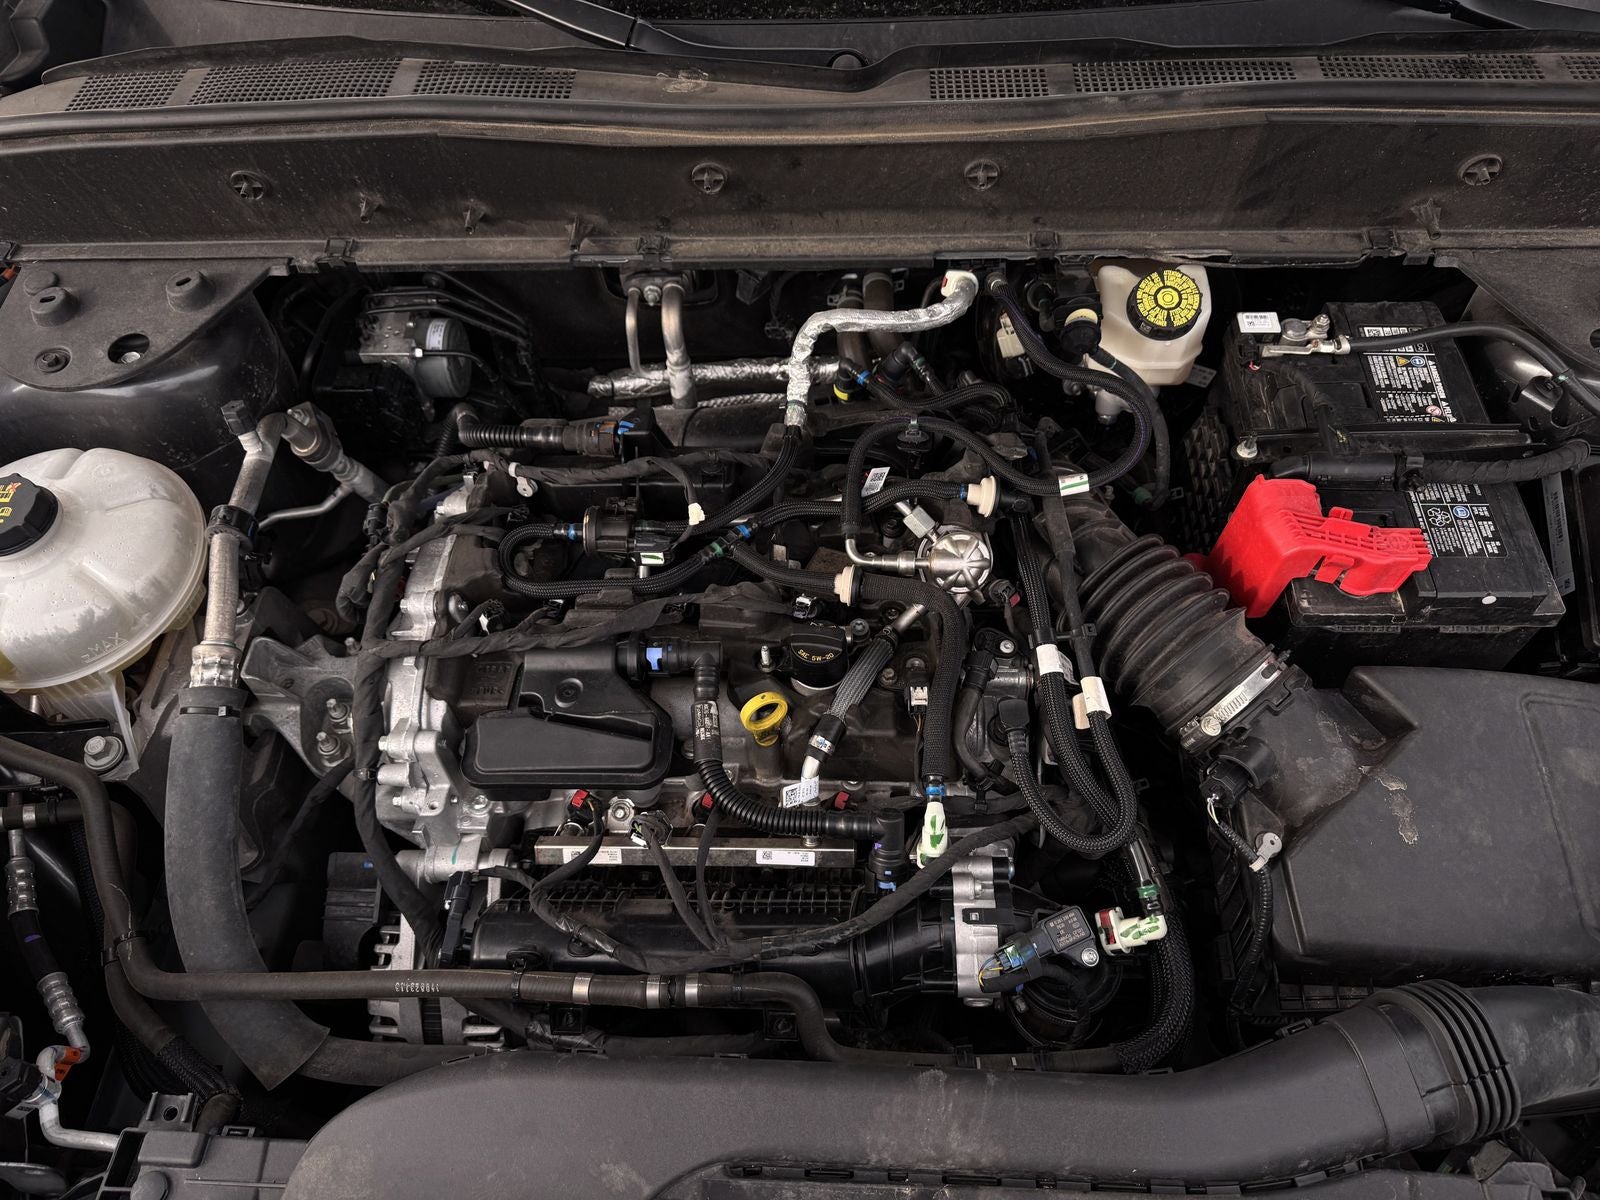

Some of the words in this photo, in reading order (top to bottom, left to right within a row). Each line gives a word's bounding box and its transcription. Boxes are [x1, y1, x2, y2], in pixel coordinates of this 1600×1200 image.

[81, 632, 129, 664] MAX
[797, 649, 810, 660] SAE
[811, 652, 835, 662] 5W-20
